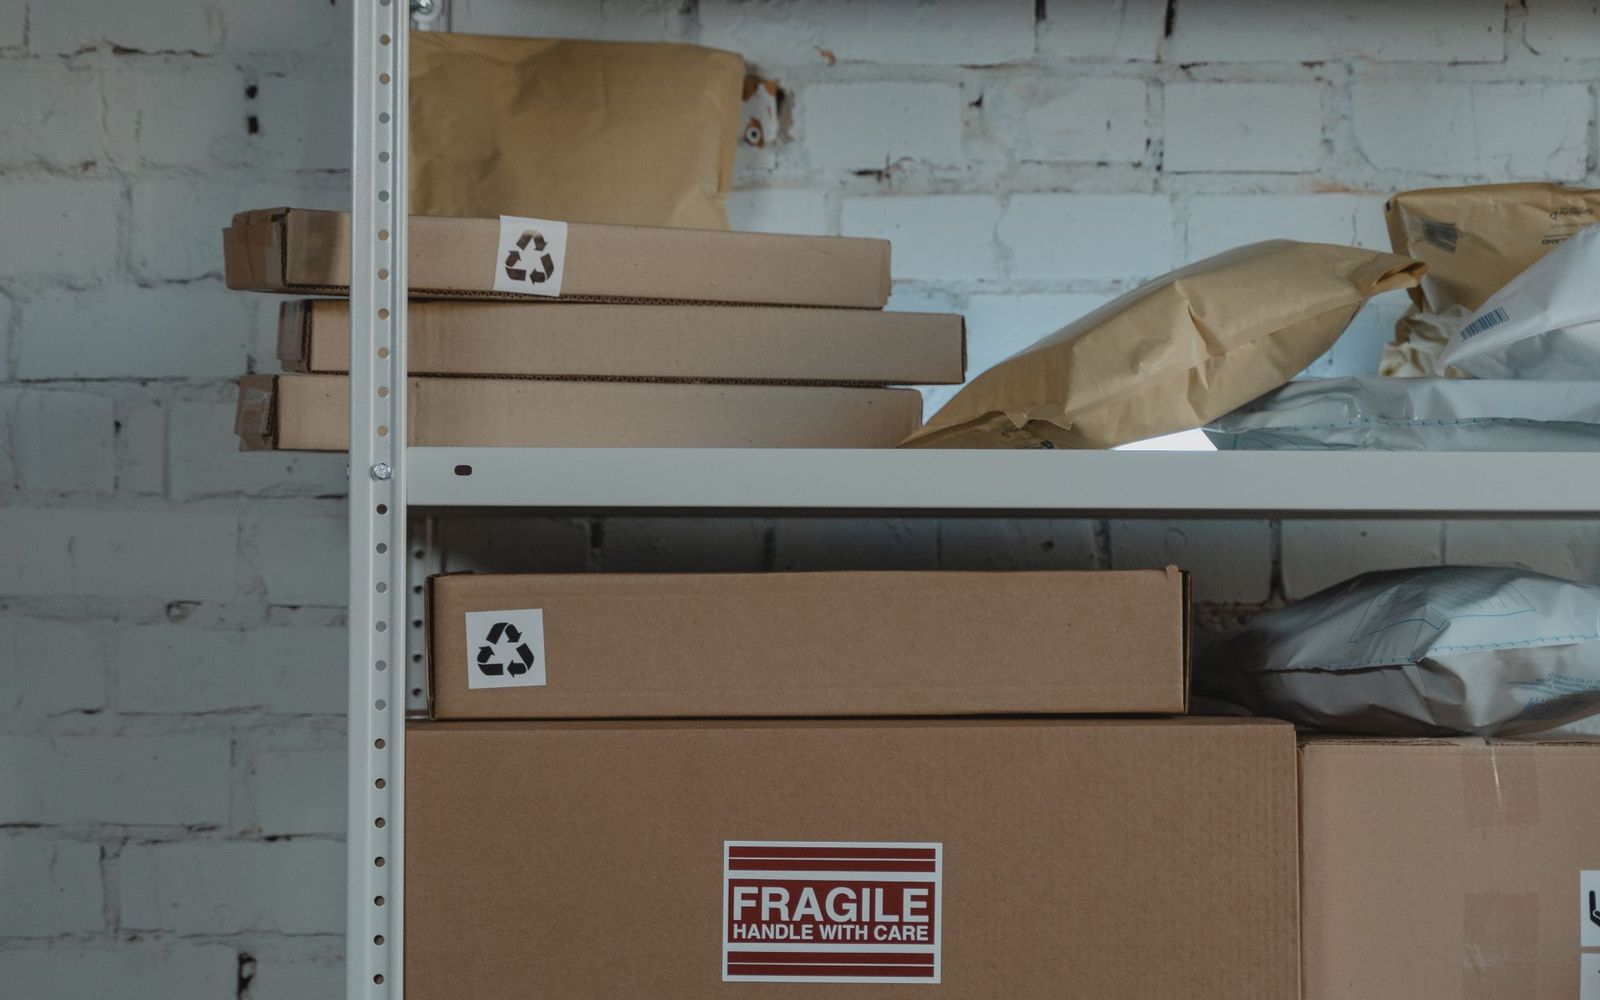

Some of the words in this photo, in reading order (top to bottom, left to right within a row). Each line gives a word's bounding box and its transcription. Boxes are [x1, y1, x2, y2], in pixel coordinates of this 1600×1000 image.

[733, 886, 929, 923] FRAGILE
[733, 923, 814, 940] HANDLE
[819, 924, 868, 941] WITH
[874, 925, 929, 941] CARE
